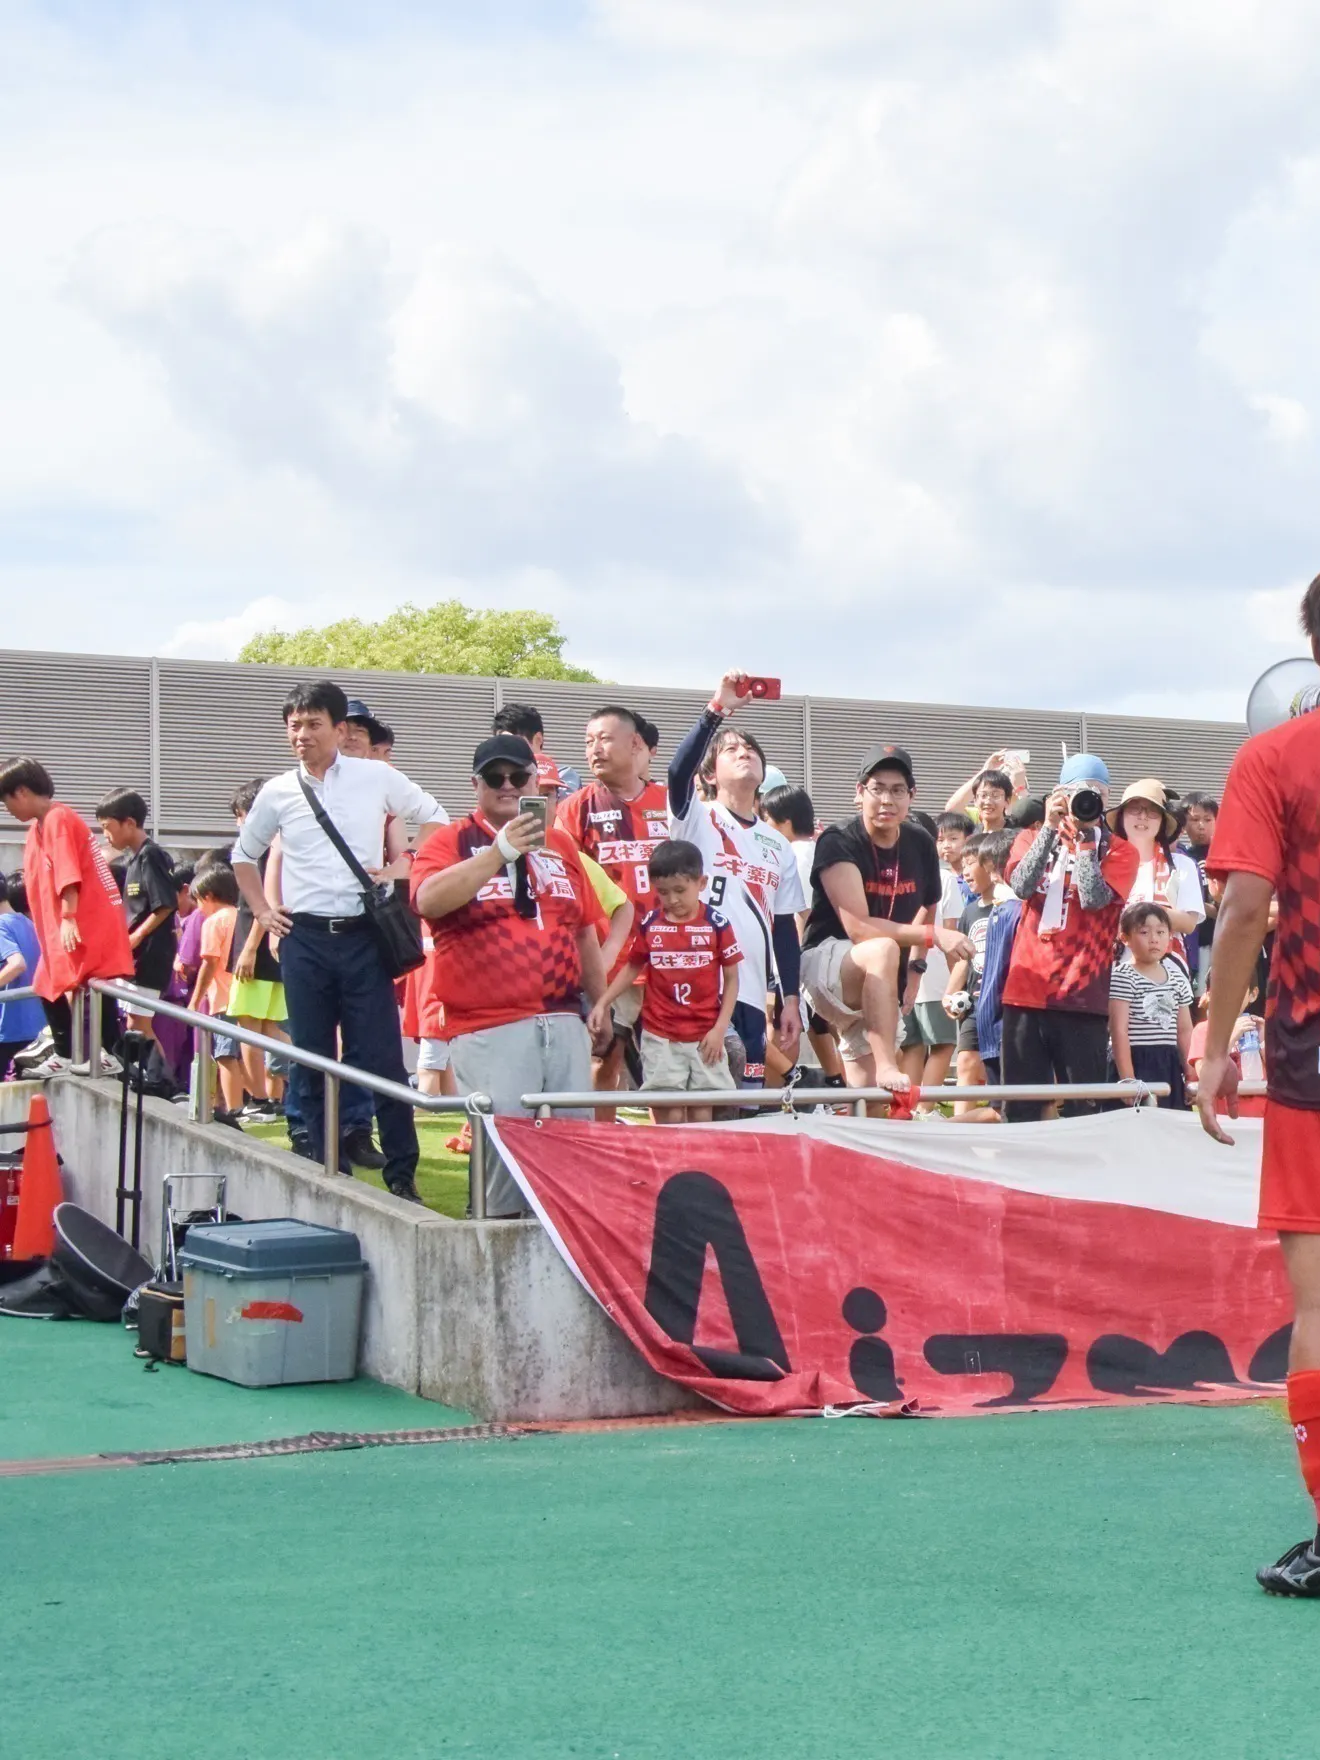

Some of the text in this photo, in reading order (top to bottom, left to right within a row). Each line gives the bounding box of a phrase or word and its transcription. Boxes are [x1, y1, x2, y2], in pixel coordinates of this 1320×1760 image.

[652, 953, 712, 968] スギ薬局
[673, 982, 692, 1006] 12
